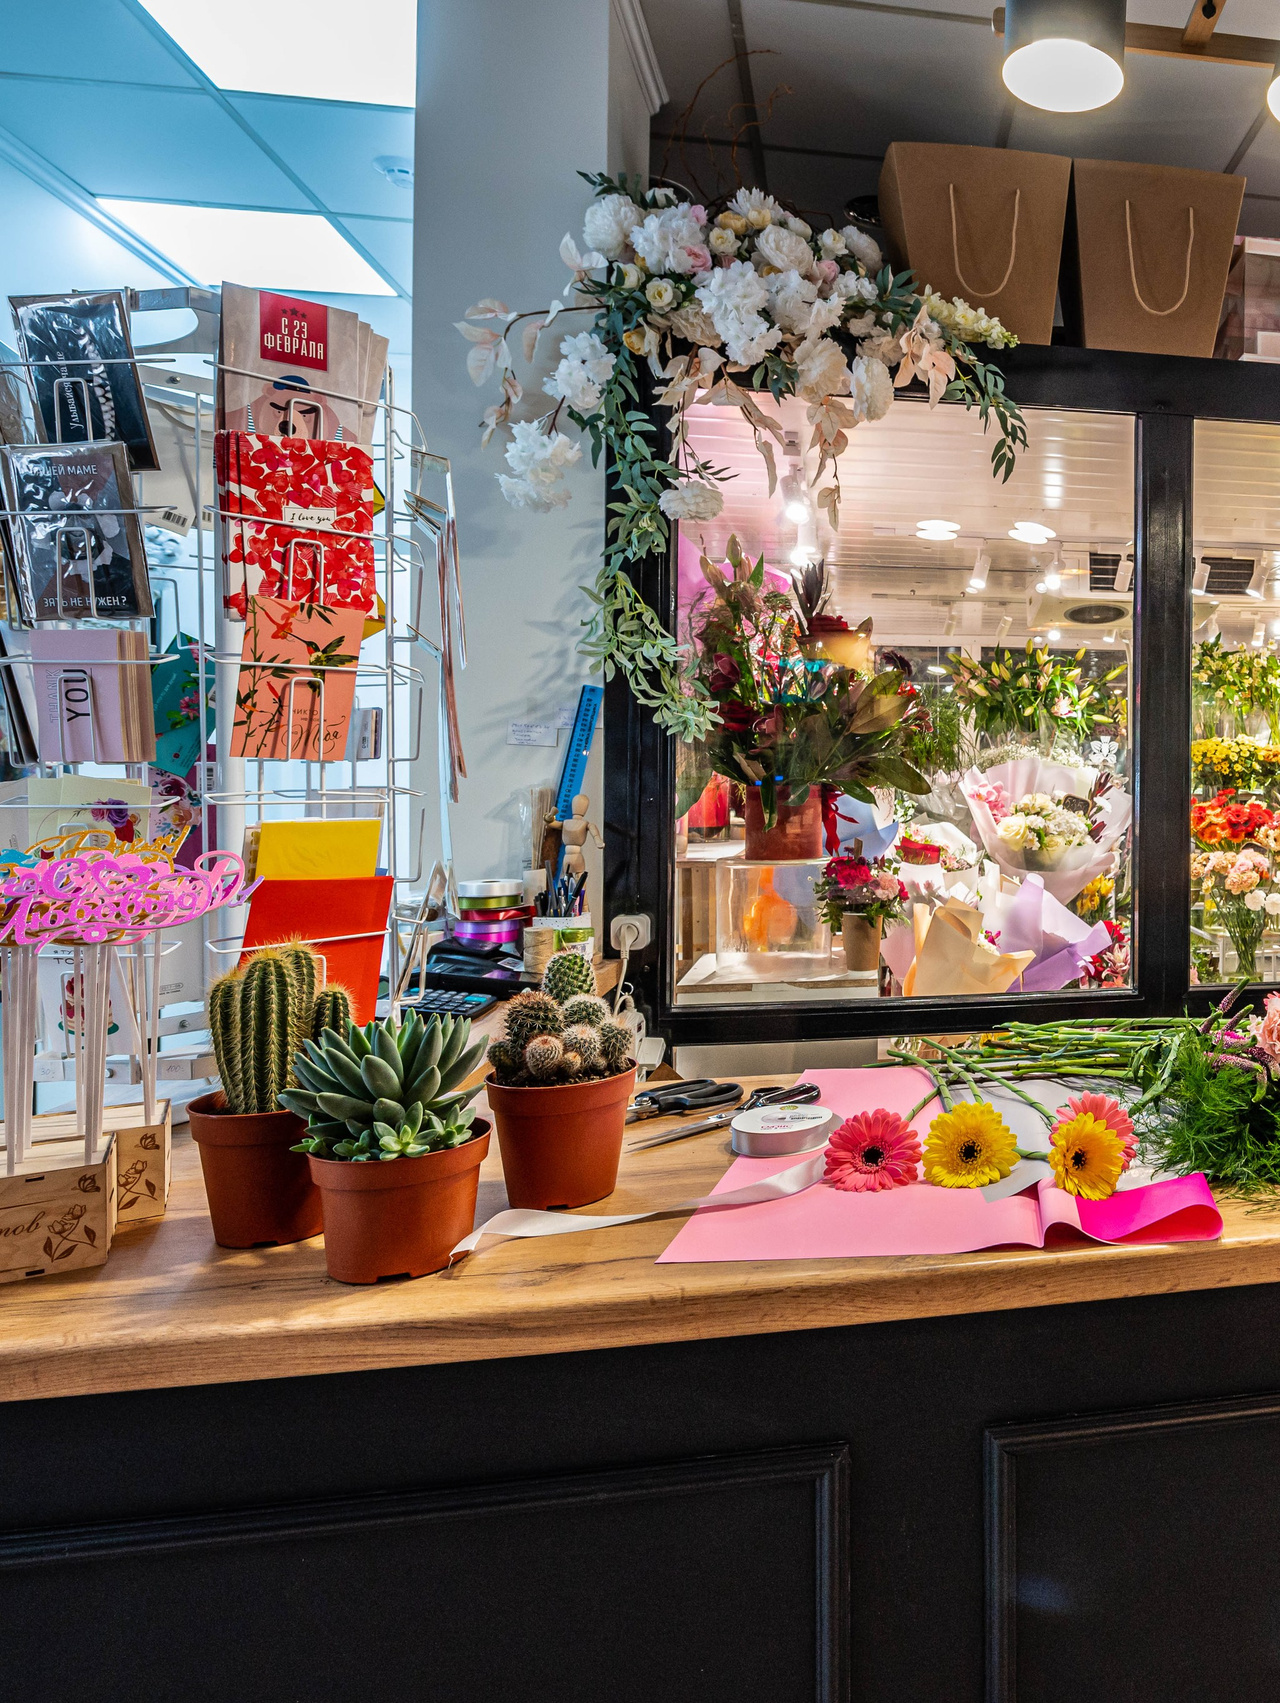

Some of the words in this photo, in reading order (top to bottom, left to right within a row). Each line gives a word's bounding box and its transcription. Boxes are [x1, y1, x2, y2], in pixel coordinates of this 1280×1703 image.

[281, 317, 288, 335] С
[293, 320, 307, 339] 23
[264, 332, 324, 360] ФЕВРАЛЯ
[67, 464, 98, 476] МАМЕ
[290, 513, 296, 521] I
[298, 513, 314, 521] love
[316, 516, 331, 524] you
[70, 597, 83, 607] НЕ
[62, 668, 91, 722] YOU
